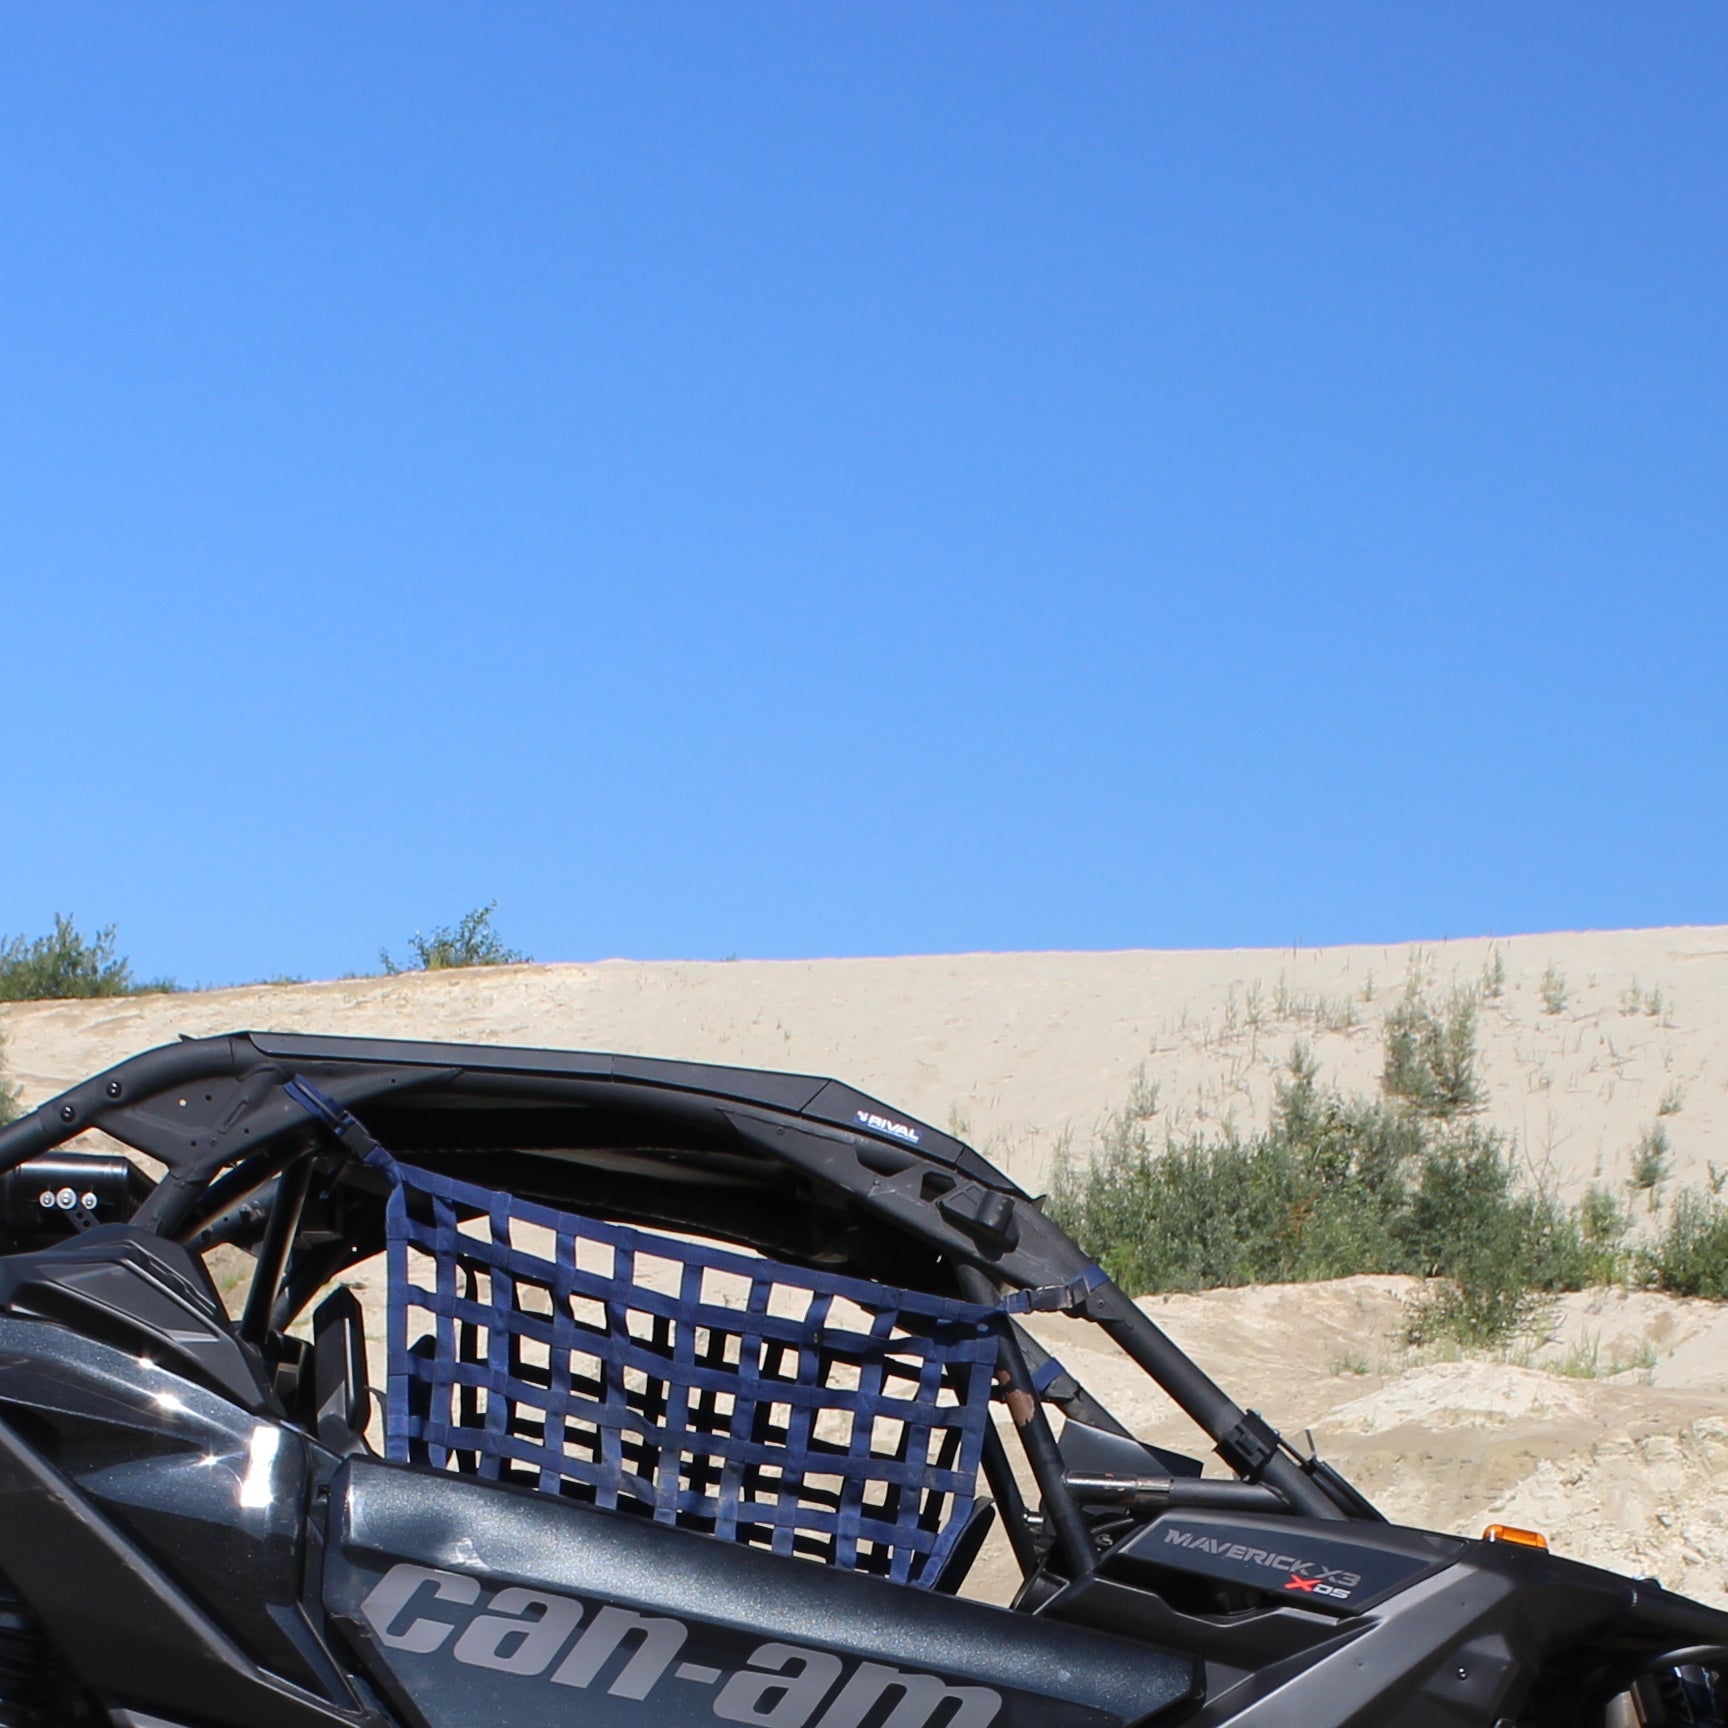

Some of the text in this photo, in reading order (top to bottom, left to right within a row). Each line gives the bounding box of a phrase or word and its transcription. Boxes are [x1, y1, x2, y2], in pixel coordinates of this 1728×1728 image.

[868, 1114, 919, 1142] RIVAL
[1163, 1529, 1362, 1588] MAVERICK X3
